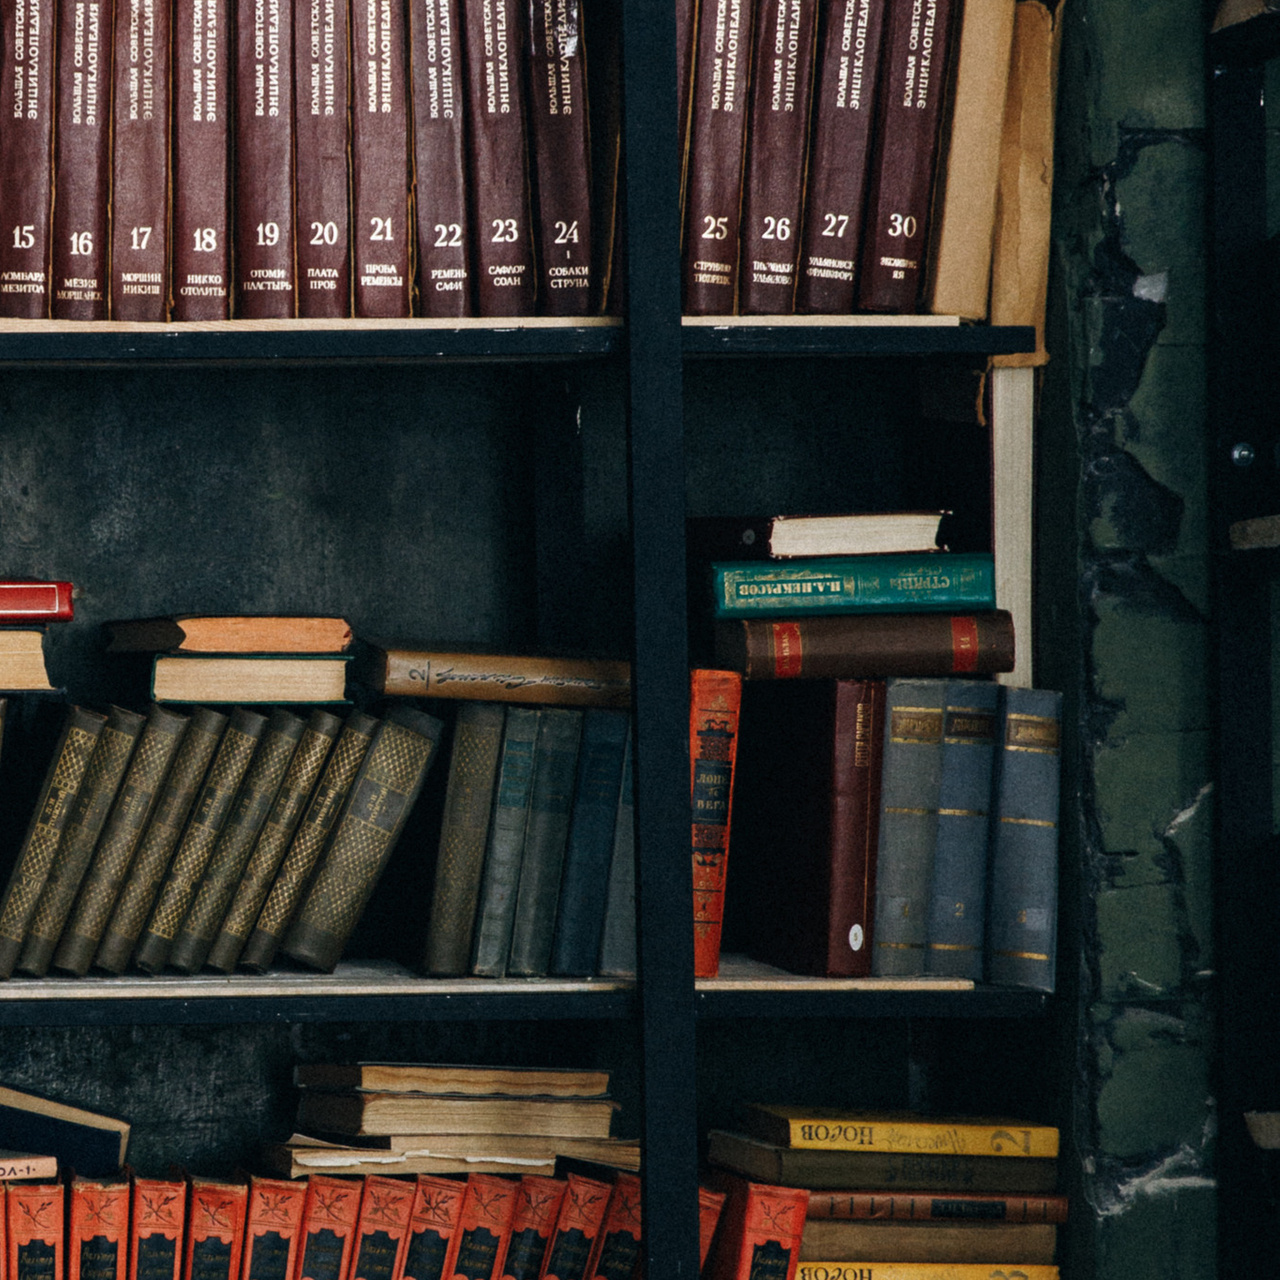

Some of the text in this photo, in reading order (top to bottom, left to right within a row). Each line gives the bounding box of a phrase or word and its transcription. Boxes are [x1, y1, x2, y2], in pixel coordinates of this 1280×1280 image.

[193, 0, 203, 121] БОЛЬШАЯ СОВЕТСКАЯ
[207, 0, 217, 122] ЭНЦИКЛОПЕДИЯ
[14, 66, 23, 119] БОЛЬШАЯ
[310, 63, 320, 115] БОЛЬШАЯ
[486, 61, 496, 114] БОЛЬШАЯ
[836, 55, 849, 108] БОЛЬШАЯ
[12, 225, 35, 249] 15
[256, 222, 280, 246] 19
[309, 221, 339, 245] 20
[370, 217, 394, 242] 21
[434, 223, 463, 247] 22
[491, 219, 519, 243] 23
[553, 220, 579, 244] 24
[701, 215, 728, 240] 25
[761, 217, 791, 241] 26
[821, 213, 850, 238] 27
[888, 213, 917, 238] 30
[70, 232, 94, 255] 16
[130, 226, 152, 250] 17
[193, 228, 217, 252] 18
[63, 278, 97, 289] МЕЗИЯ
[307, 268, 339, 278] ПЛАТА
[548, 266, 589, 277] СОБАКИ
[550, 278, 590, 289] СТРУНА
[123, 284, 160, 295] НИКИШ
[180, 285, 227, 297] ОТОЛИТЫ
[310, 280, 337, 290] ПРОБ
[696, 799, 727, 811] ВЕГА
[990, 1131, 1019, 1152] 2
